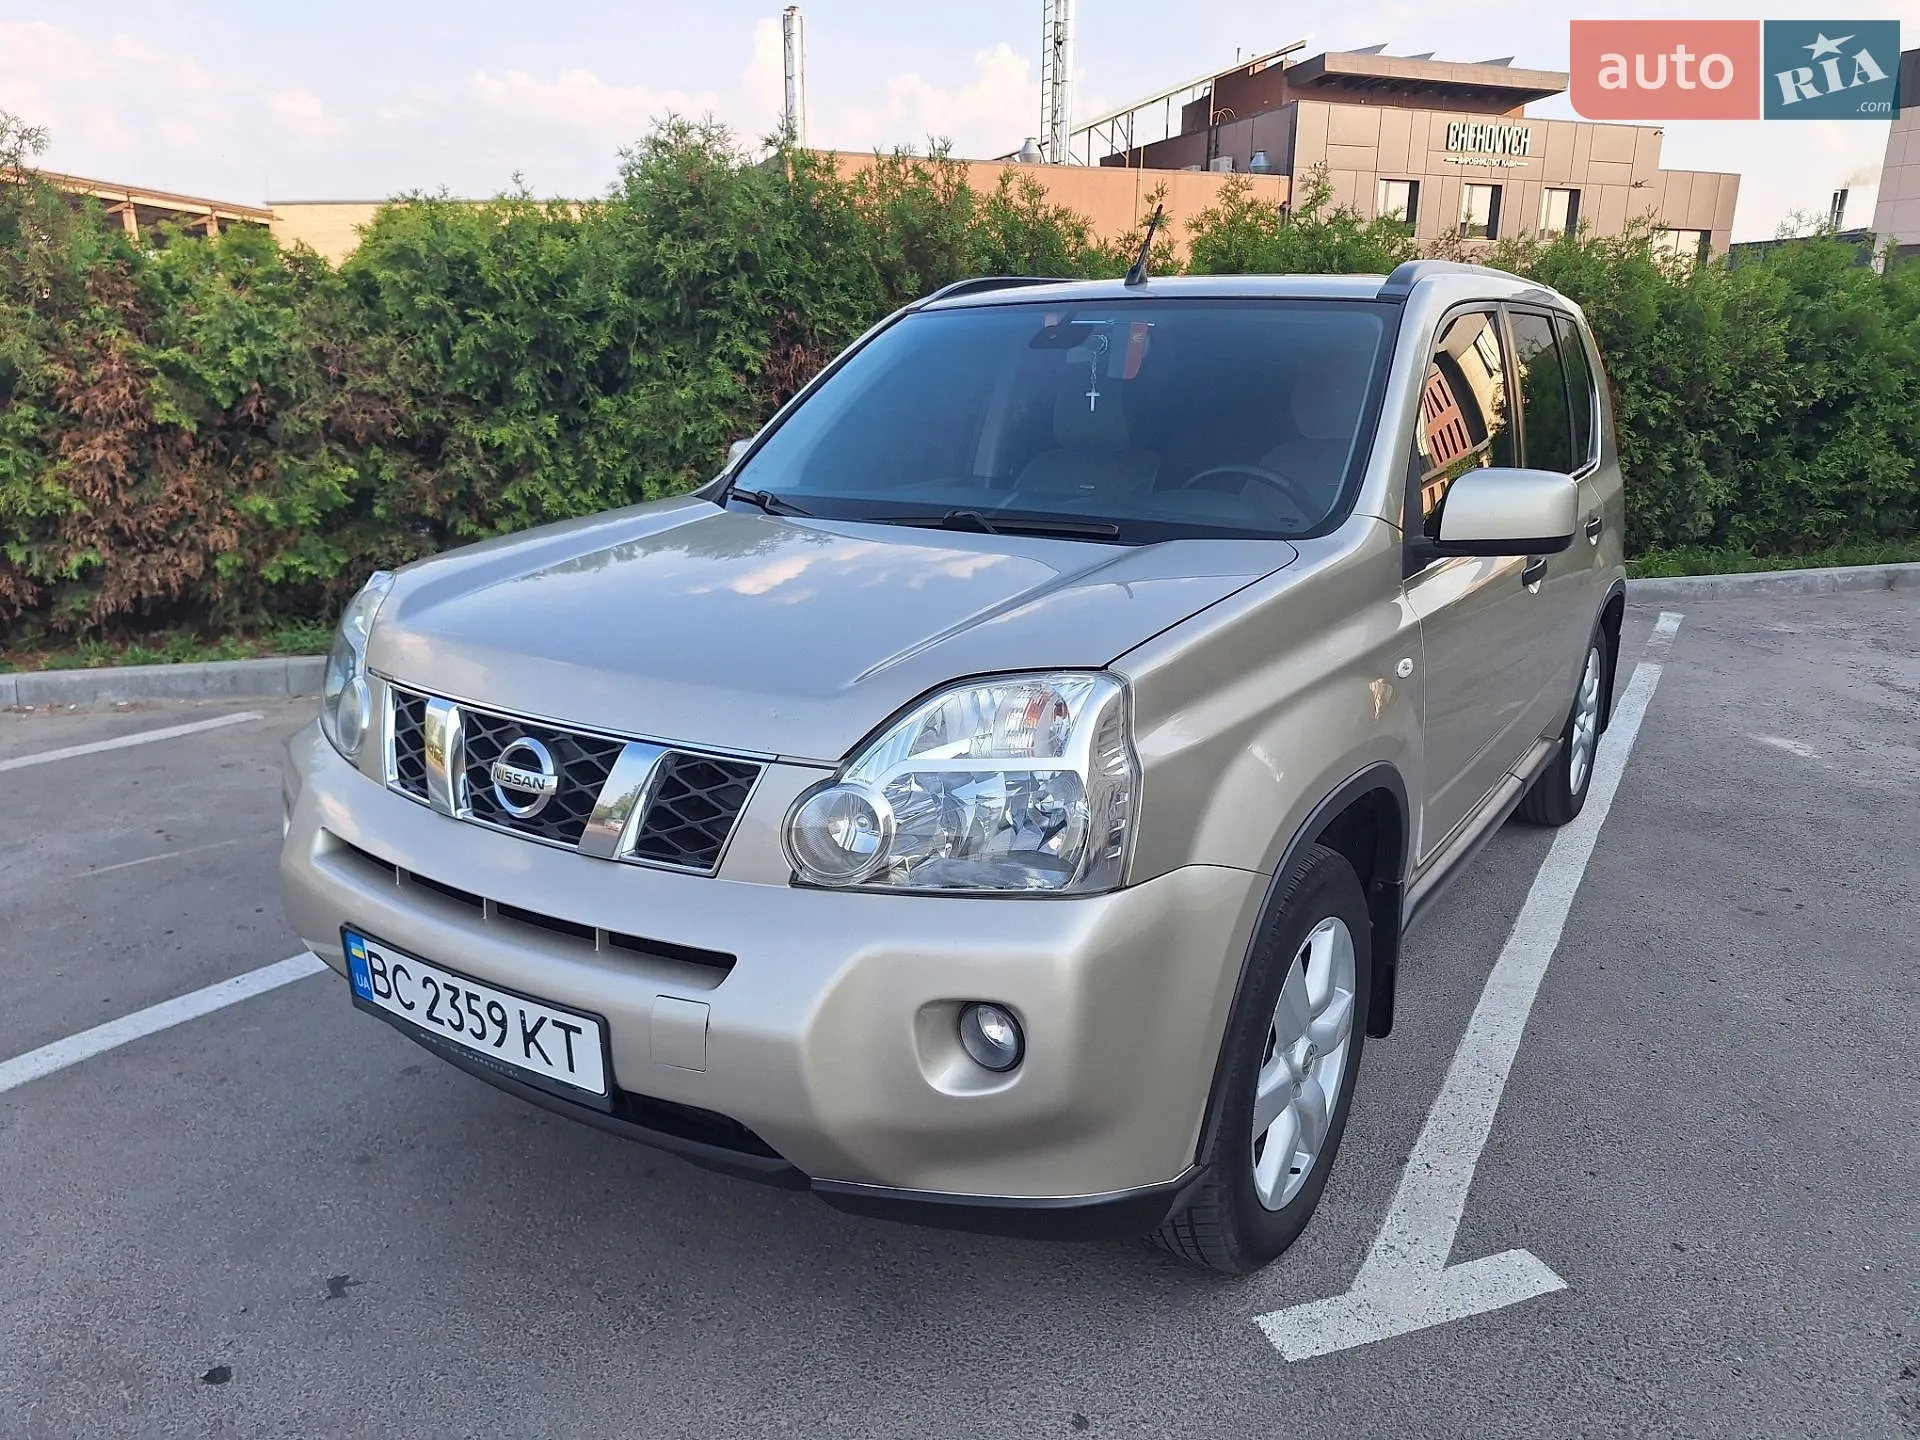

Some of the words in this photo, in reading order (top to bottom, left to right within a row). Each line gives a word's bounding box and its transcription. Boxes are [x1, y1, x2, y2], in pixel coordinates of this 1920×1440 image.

[1446, 121, 1532, 156] CHEHOVYCH
[493, 765, 546, 790] NISSAN
[356, 972, 371, 991] UA
[367, 949, 415, 1011] BC
[422, 976, 508, 1048] 2359
[519, 1009, 583, 1073] KT
